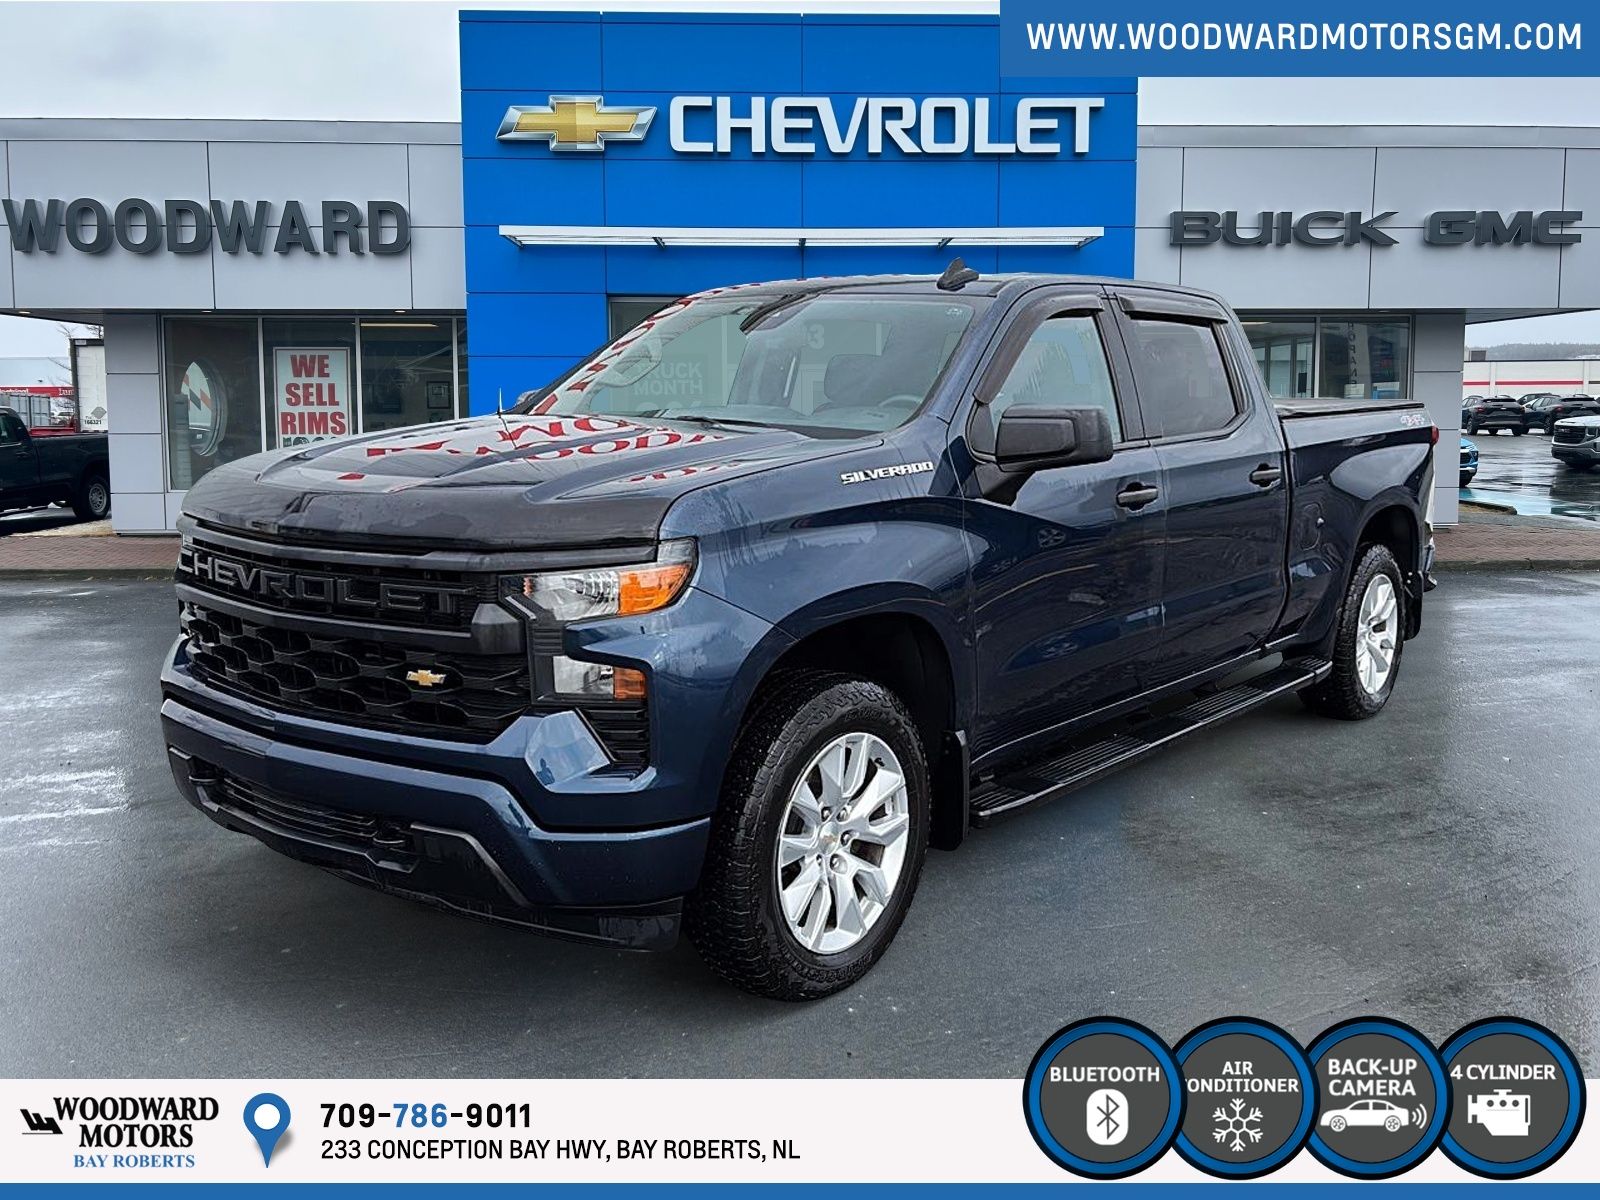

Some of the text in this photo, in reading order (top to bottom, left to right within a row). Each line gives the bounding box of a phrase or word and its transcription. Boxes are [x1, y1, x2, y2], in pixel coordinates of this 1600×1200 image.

[669, 96, 1105, 155] CHEVROLET
[3, 197, 411, 255] WOODWARD
[1169, 210, 1583, 247] BUICK GMC
[290, 354, 330, 378] WE
[285, 382, 340, 407] SELL
[280, 411, 346, 436] RIMS
[840, 461, 934, 485] SILVERADO
[178, 550, 477, 614] CHEVROLET
